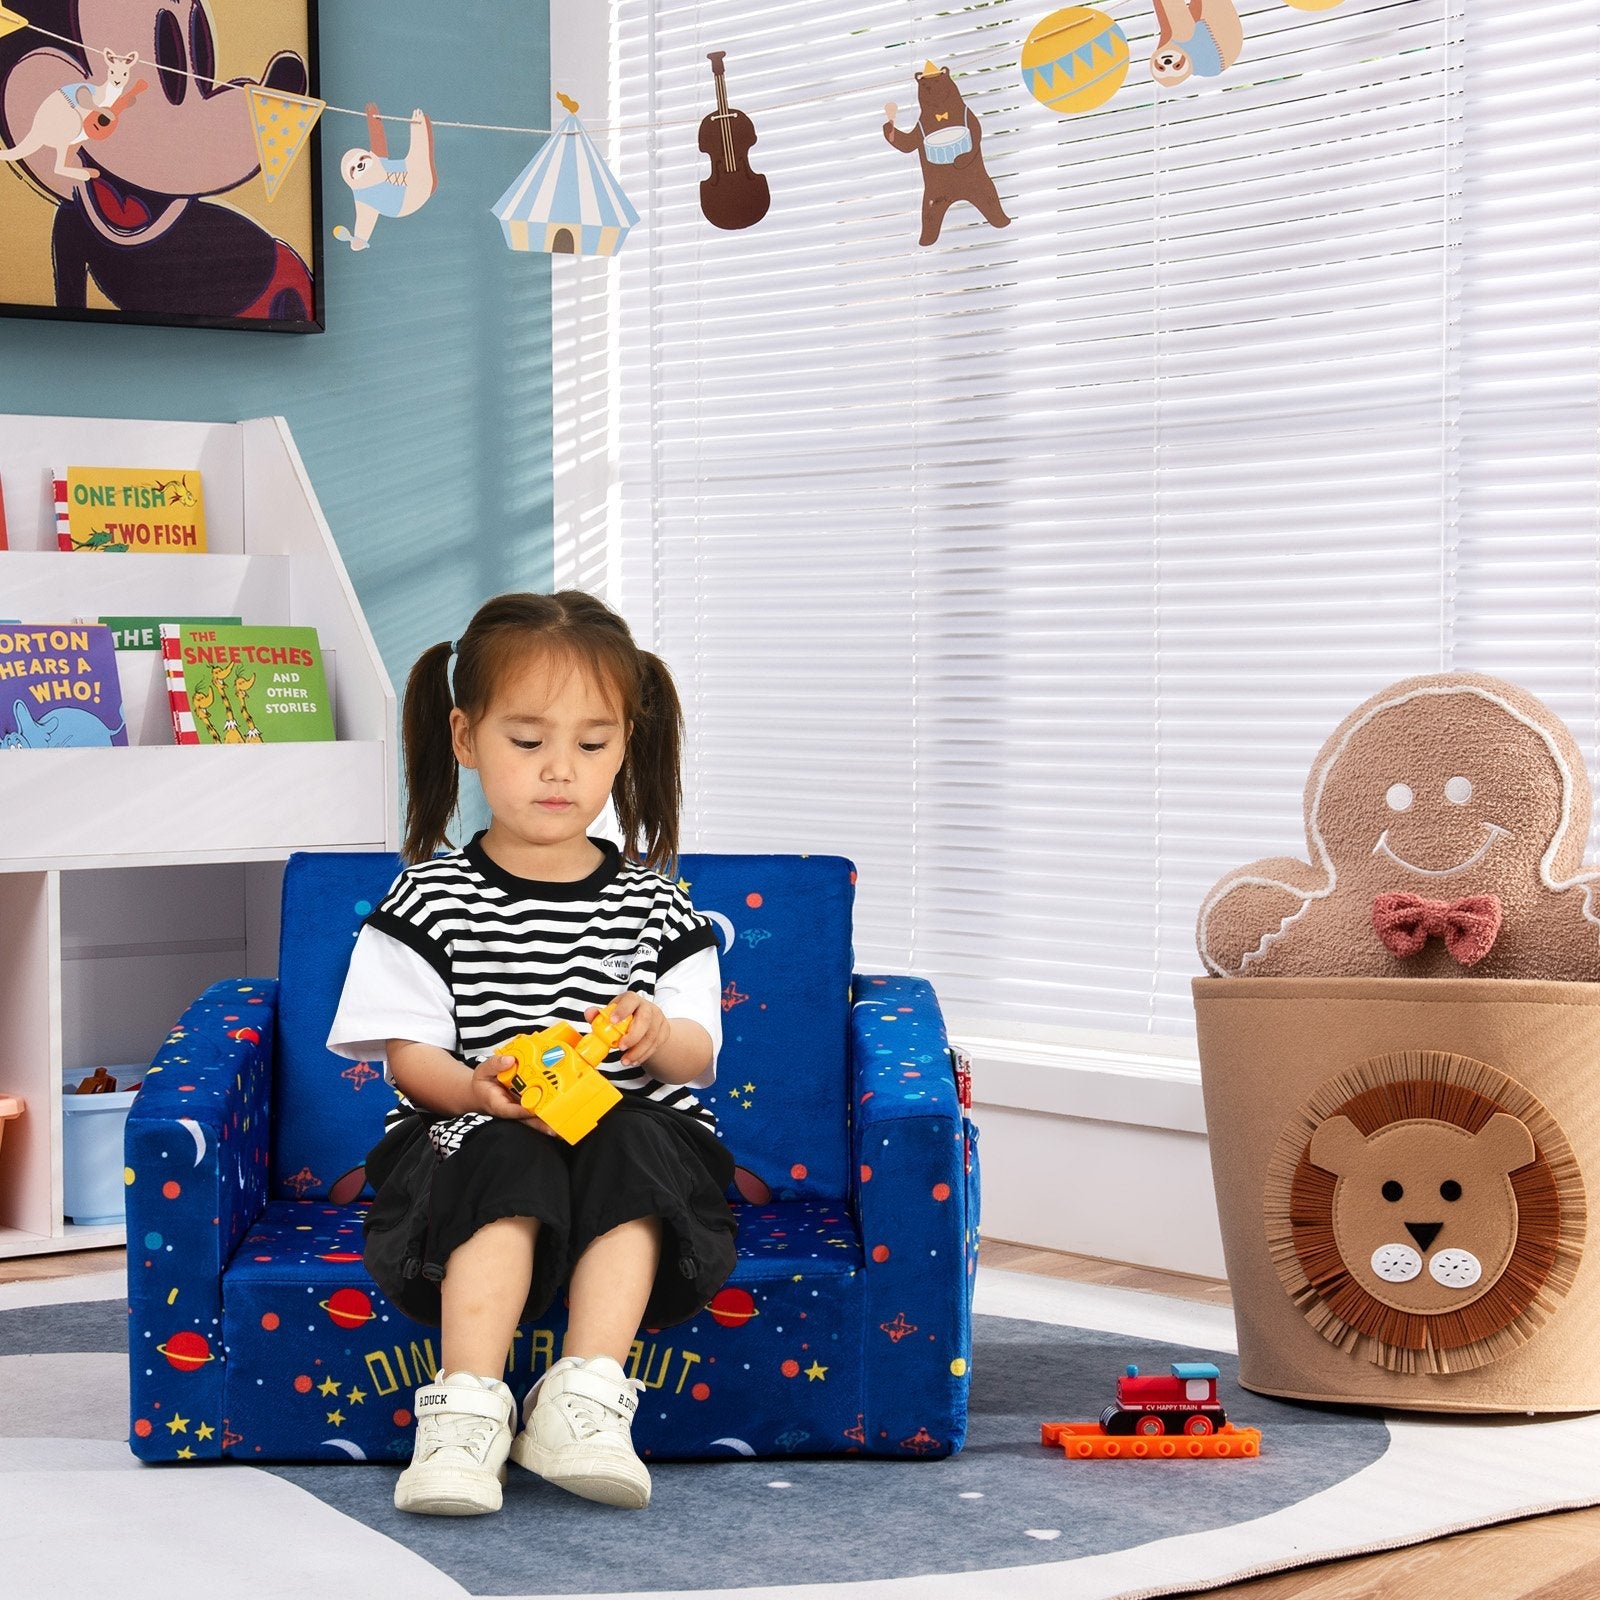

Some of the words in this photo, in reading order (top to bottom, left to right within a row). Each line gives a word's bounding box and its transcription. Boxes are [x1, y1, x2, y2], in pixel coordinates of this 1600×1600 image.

[74, 484, 115, 507] ONE
[123, 486, 166, 509] FISH
[105, 523, 150, 545] TWO
[153, 524, 197, 546] FISH
[112, 628, 154, 648] THE
[189, 631, 216, 643] THE
[183, 646, 314, 667] SNEETCHES
[0, 658, 70, 680] HEARS
[77, 657, 92, 675] A
[272, 673, 300, 683] AND
[28, 679, 101, 704] WHO!
[266, 687, 308, 698] OTHER
[265, 702, 317, 714] STORIES
[419, 1394, 448, 1408] B.DUCK
